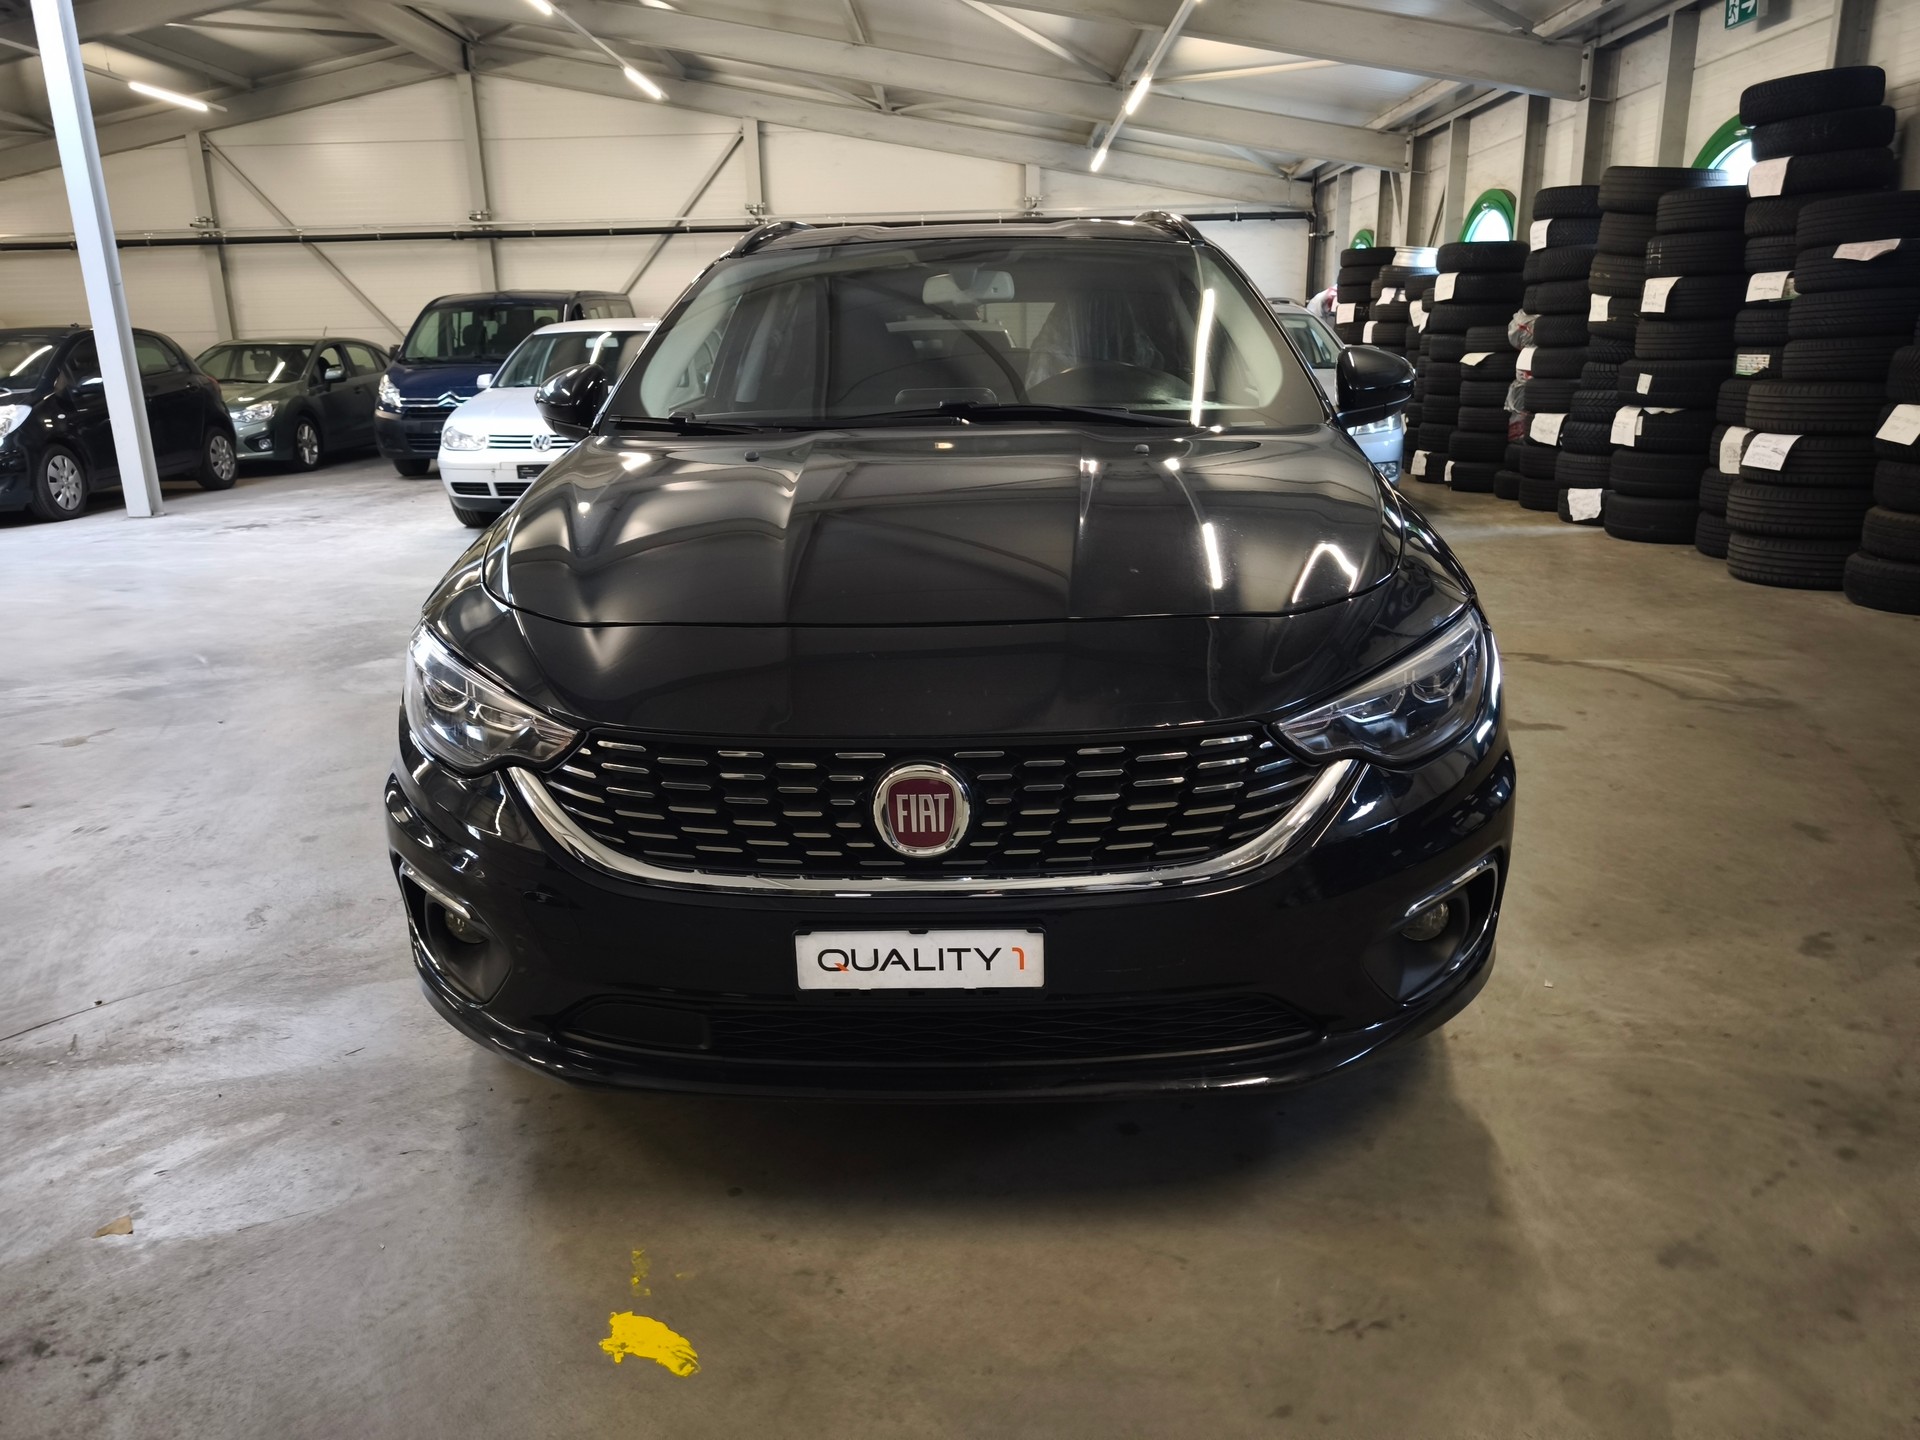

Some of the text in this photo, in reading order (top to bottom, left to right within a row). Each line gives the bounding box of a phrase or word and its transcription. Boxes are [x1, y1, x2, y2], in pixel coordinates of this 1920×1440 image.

[896, 793, 949, 833] FIAT
[817, 947, 1025, 972] QUALITY 1
